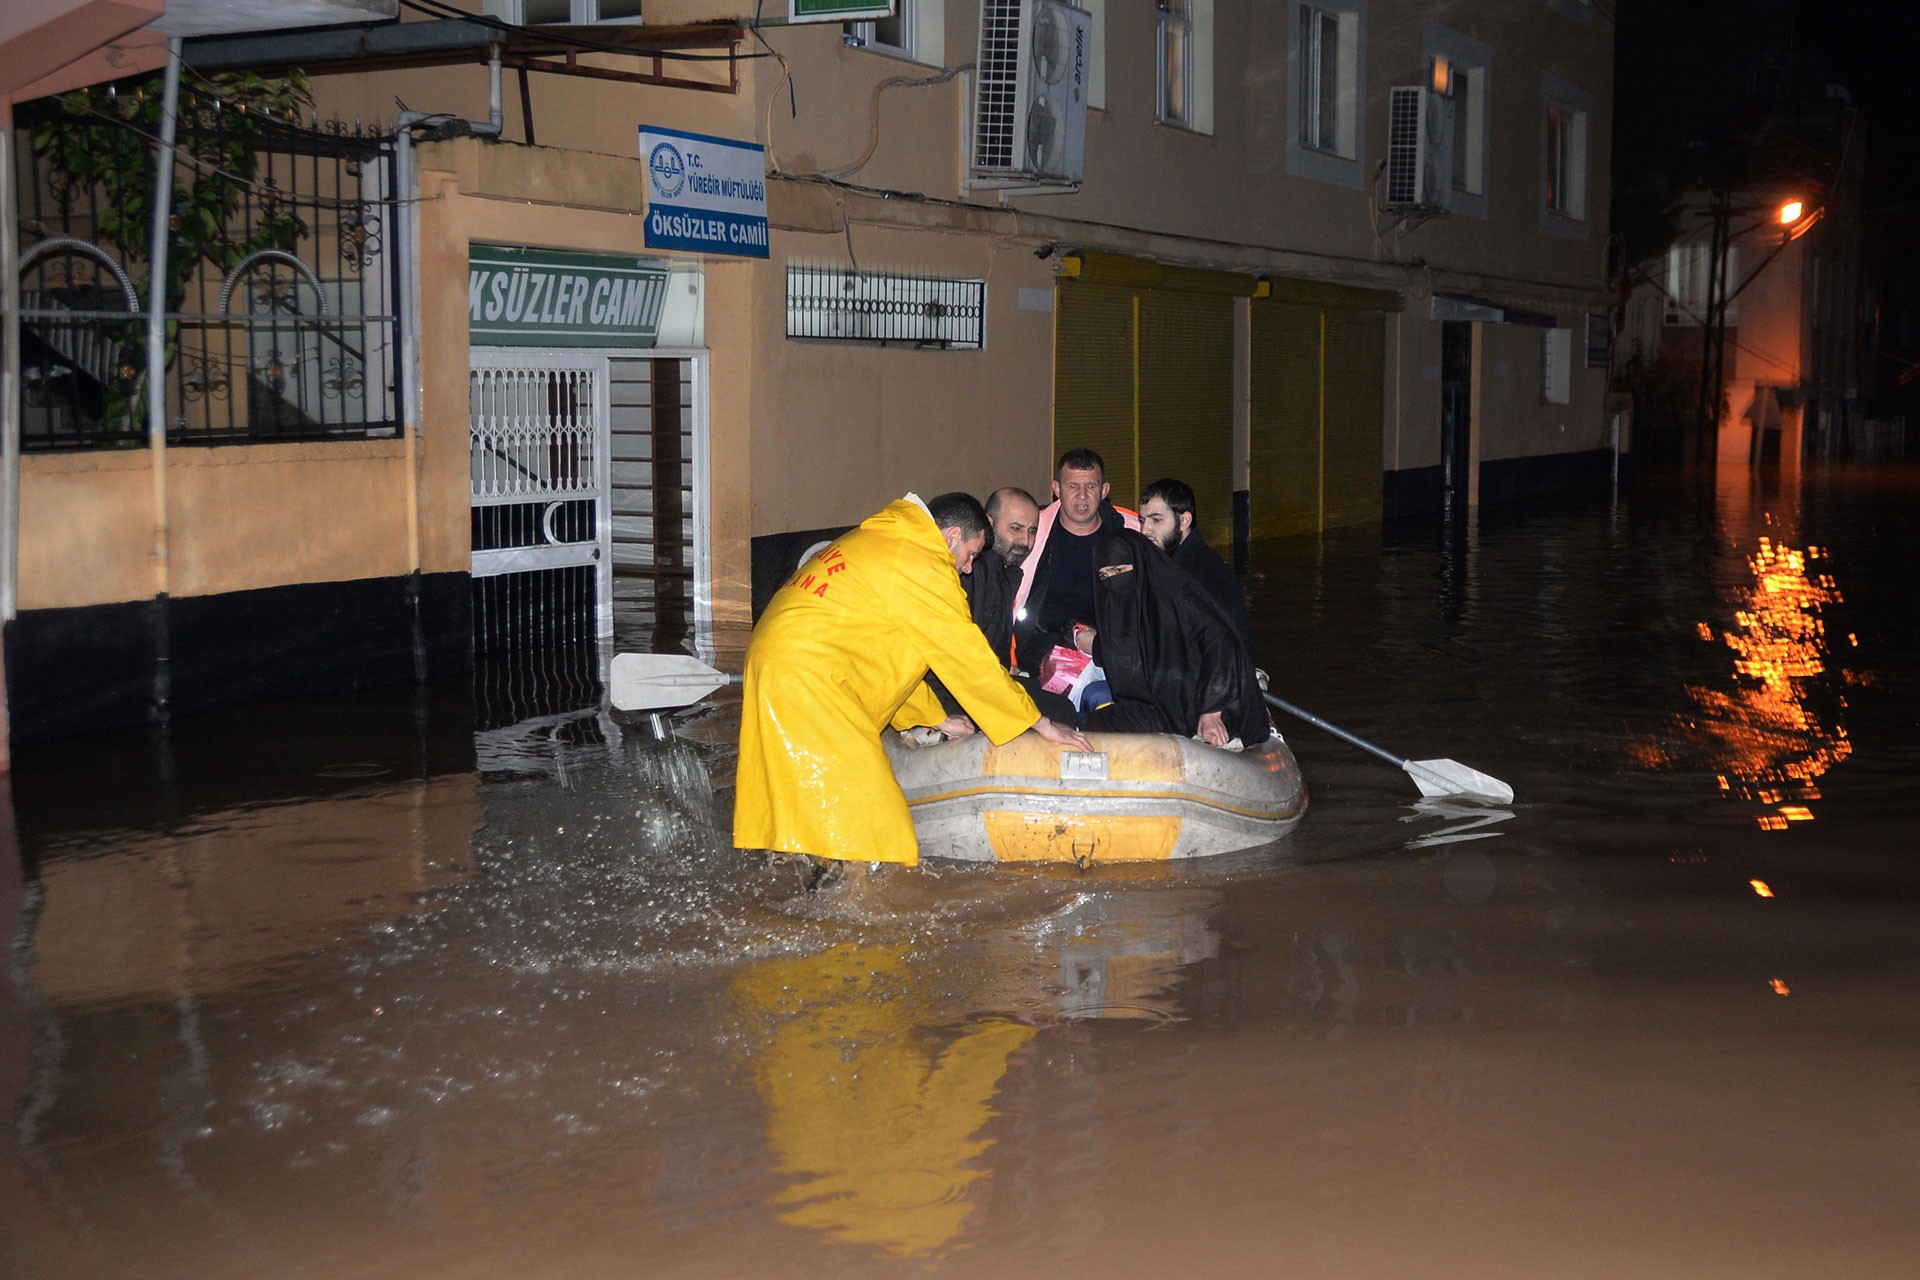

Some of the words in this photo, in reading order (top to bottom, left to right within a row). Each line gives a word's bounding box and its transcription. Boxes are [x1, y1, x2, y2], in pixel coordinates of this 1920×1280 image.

[686, 153, 703, 168] T.C.
[687, 172, 721, 196] YÜREĞİR
[721, 177, 765, 202] MÜFTÜLÜĞÜ
[652, 209, 727, 242] ÖKSÜZLER
[729, 222, 767, 246] CAMİİ
[589, 275, 665, 327] CAMİİ
[816, 544, 847, 577] İYE
